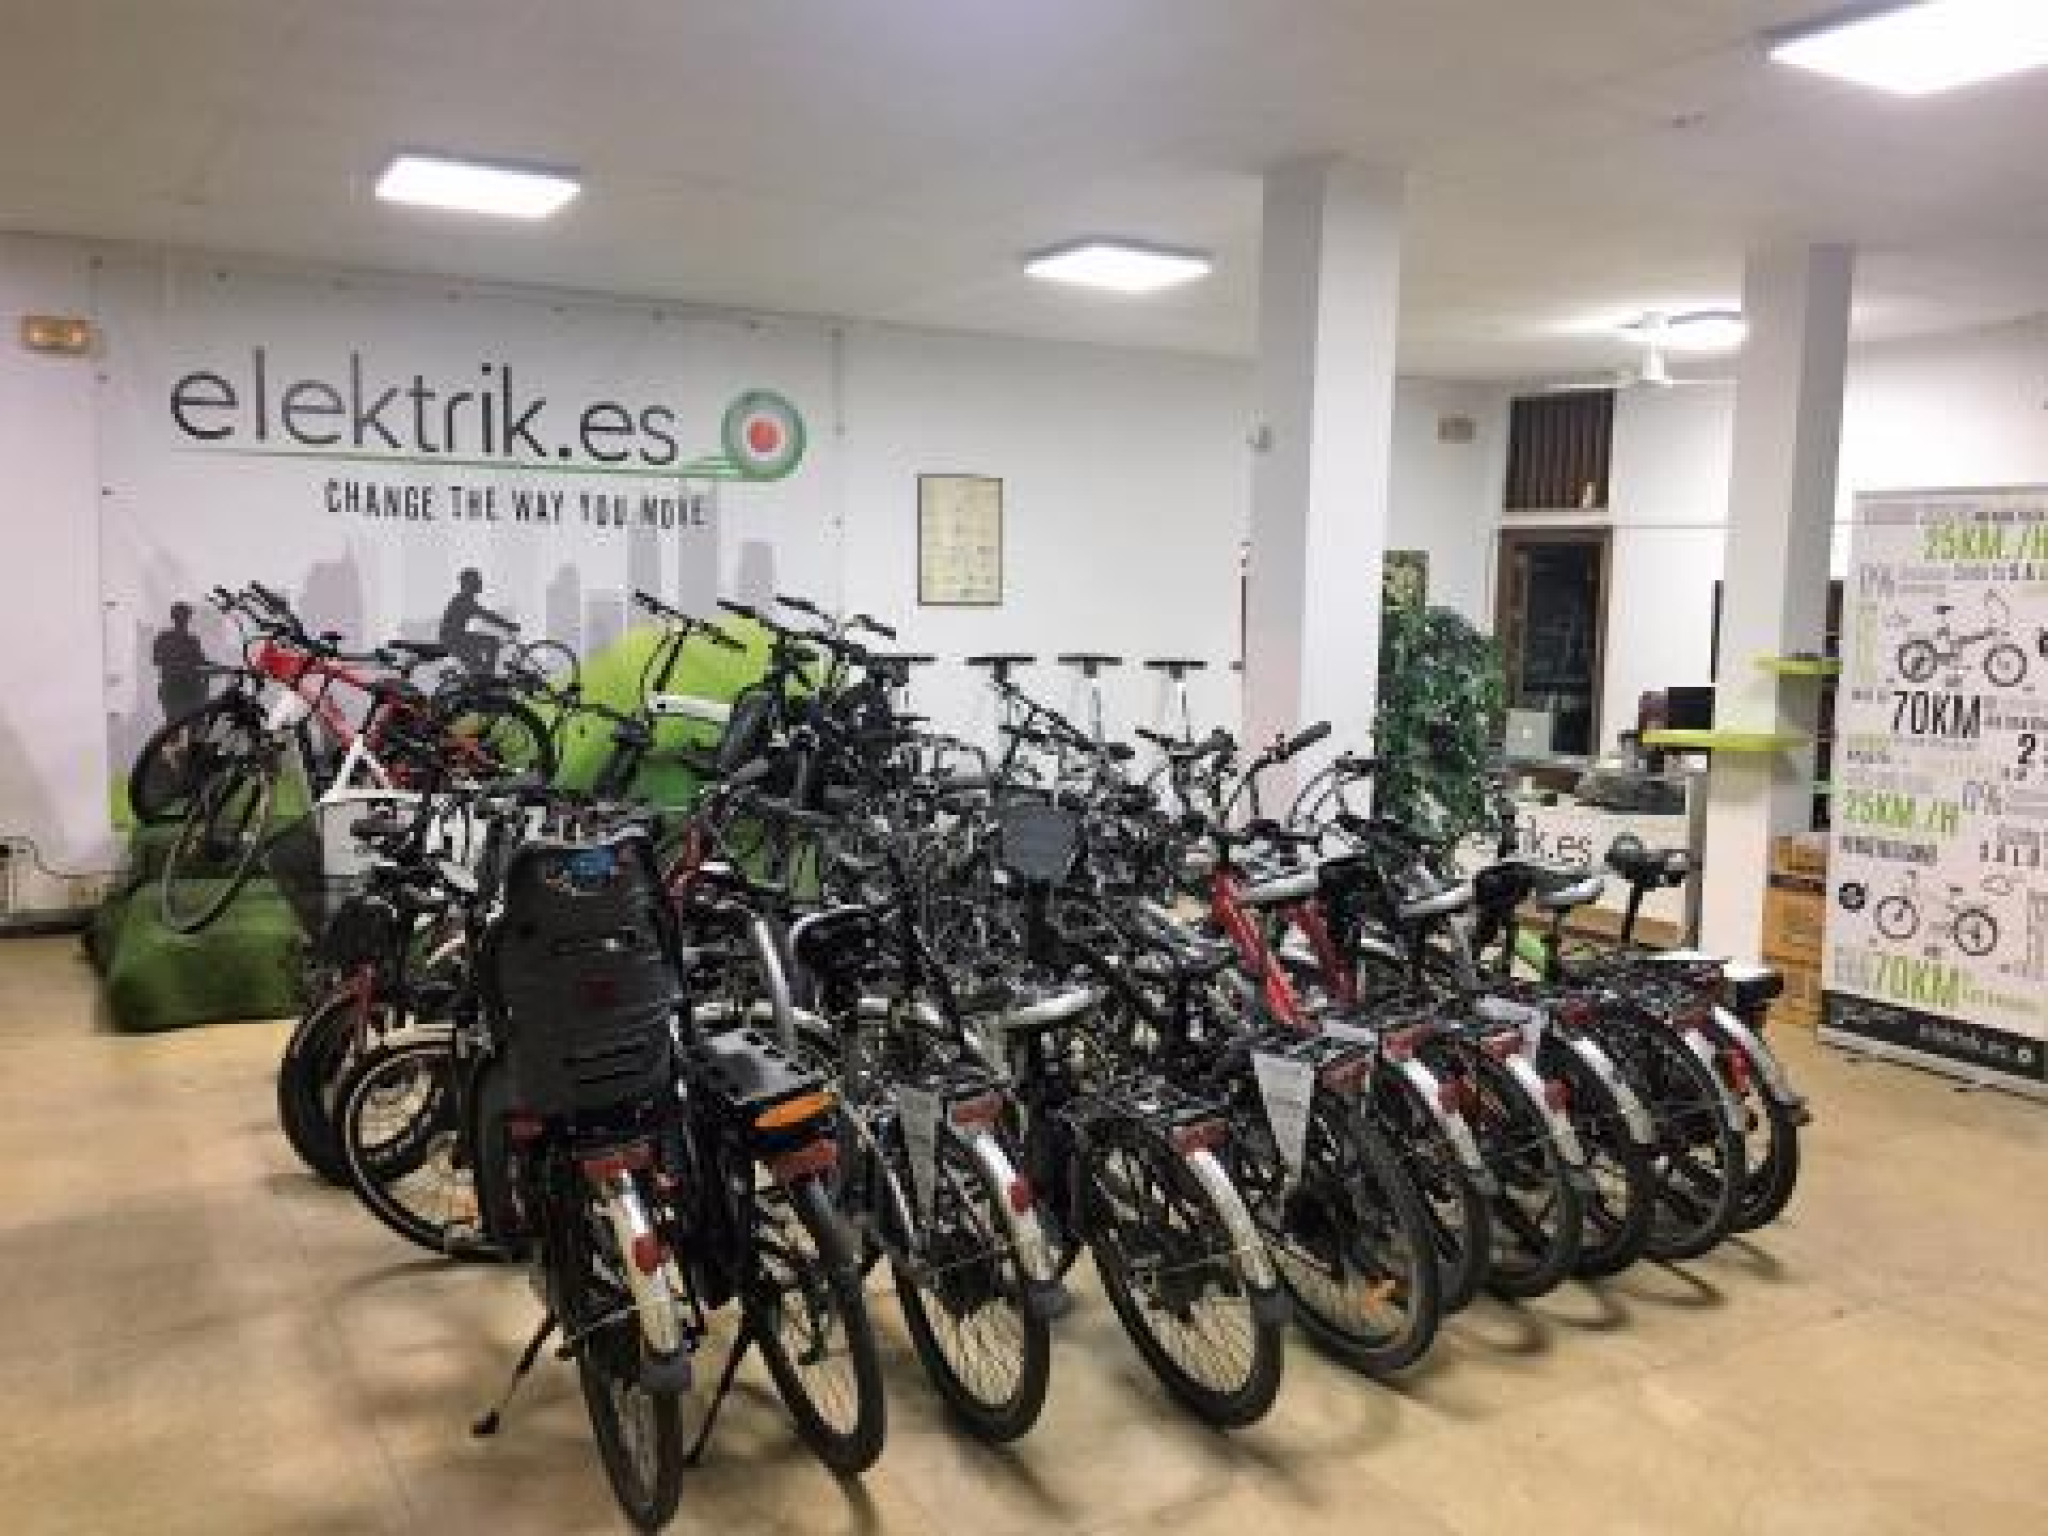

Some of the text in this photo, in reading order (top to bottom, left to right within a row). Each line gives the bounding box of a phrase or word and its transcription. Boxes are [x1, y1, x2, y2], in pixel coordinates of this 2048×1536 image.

[170, 346, 680, 466] elektrik.es
[325, 478, 435, 522] CHANGE
[451, 485, 498, 522] THE
[511, 491, 565, 523] WAY
[579, 493, 629, 528] YOU
[1893, 690, 1981, 739] 70KM
